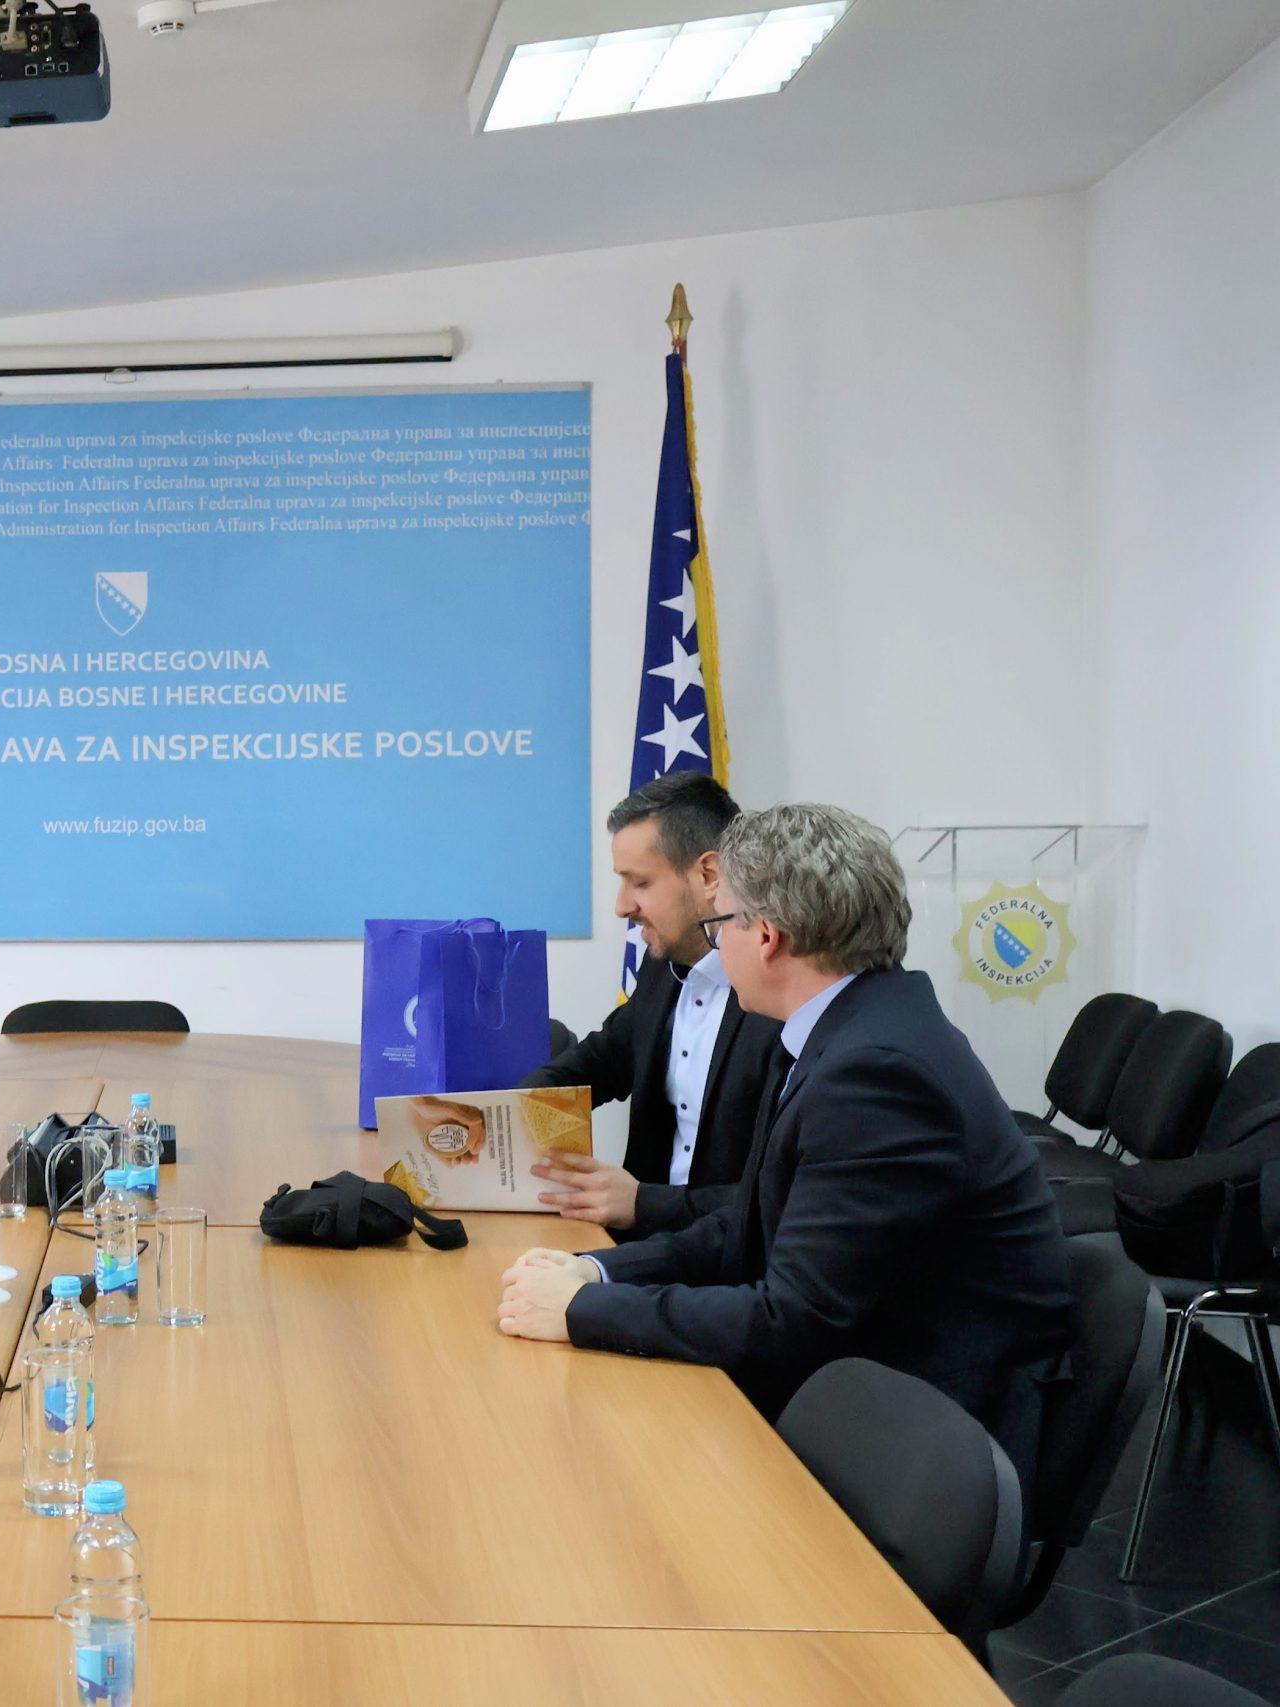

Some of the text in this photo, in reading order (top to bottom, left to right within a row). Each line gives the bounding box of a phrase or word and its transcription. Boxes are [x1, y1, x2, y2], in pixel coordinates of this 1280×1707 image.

[67, 434, 115, 450] uprava
[121, 434, 136, 445] za
[142, 428, 231, 449] inspekcijske
[236, 427, 293, 447] poslove
[298, 425, 389, 446] Федерална
[395, 427, 452, 444] управа
[458, 427, 474, 438] за
[3, 454, 53, 470] Affairs
[63, 452, 133, 469] Federalna
[139, 455, 188, 471] uprava
[193, 454, 208, 466] za
[214, 448, 304, 469] inspekcijske
[309, 447, 365, 467] poslove
[371, 445, 463, 466] Федерална
[469, 448, 525, 464] управа
[533, 447, 547, 459] за
[0, 475, 74, 496] Inspection
[80, 474, 128, 490] Affairs
[134, 473, 205, 489] Federalna
[211, 475, 259, 491] uprava
[265, 475, 280, 486] za
[286, 469, 376, 490] inspekcijske
[382, 468, 438, 488] poslove
[444, 466, 535, 487] Федерална
[39, 498, 59, 513] for
[64, 496, 139, 517] Inspection
[144, 495, 193, 511] Affairs
[199, 493, 271, 510] Federalna
[276, 496, 325, 512] uprava
[331, 496, 346, 507] za
[352, 490, 442, 510] inspekcijske
[447, 488, 504, 508] poslove
[109, 519, 129, 535] for
[135, 517, 209, 538] Inspection
[215, 516, 265, 532] Affairs
[271, 515, 342, 531] Federalna
[347, 518, 397, 534] uprava
[402, 517, 418, 528] za
[424, 511, 513, 532] inspekcijske
[519, 510, 576, 530] poslove
[74, 653, 78, 672] I
[87, 650, 269, 672] HERCEGOVINA
[59, 687, 144, 707] BOSNE
[153, 687, 158, 705] I
[166, 683, 347, 704] HERCEGOVINE
[76, 736, 120, 762] ZA
[133, 732, 362, 761] INSPEKCIJSKE
[376, 730, 532, 757] POSLOVE
[43, 816, 206, 837] www.fuzip.gov.ba
[975, 900, 1054, 929] FEDERALNA
[976, 958, 1053, 985] INSPEKCIJA
